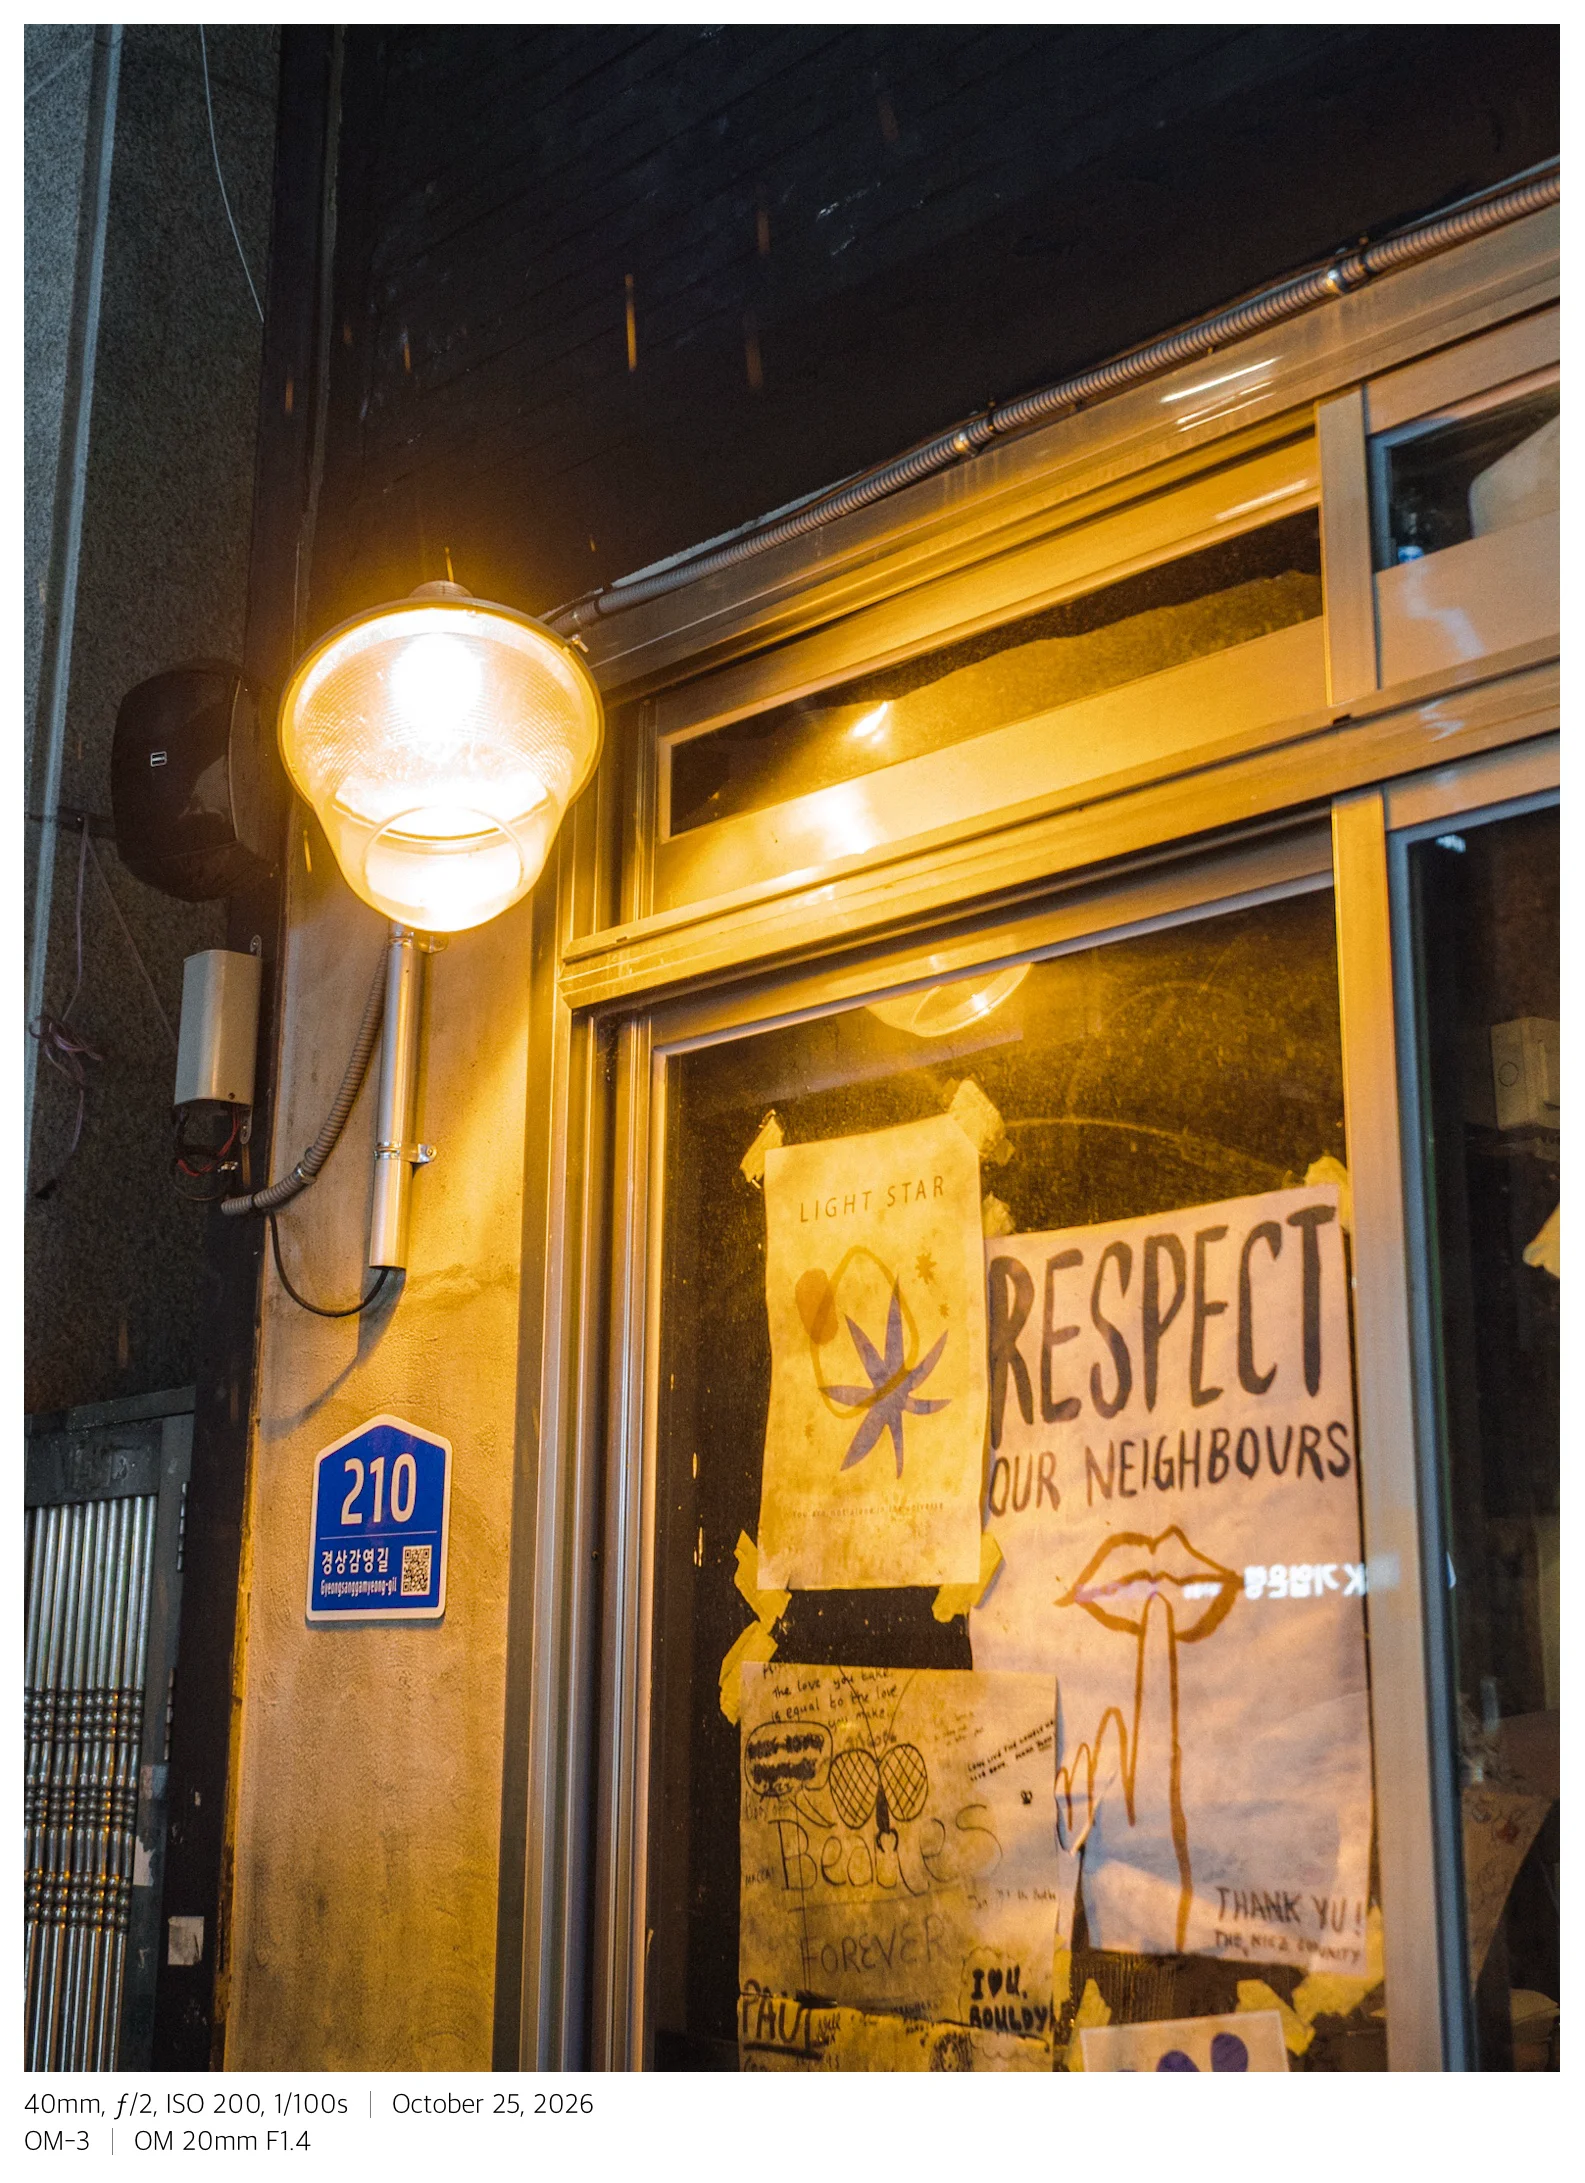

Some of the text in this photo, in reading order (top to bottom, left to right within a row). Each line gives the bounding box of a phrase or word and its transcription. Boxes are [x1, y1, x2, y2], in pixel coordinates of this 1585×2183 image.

[800, 1175, 944, 1223] LIGHT STAR
[988, 1204, 1336, 1450] RESPECT
[341, 1452, 417, 1525] 210
[988, 1421, 1351, 1518] OUR NEIGHBOURS
[321, 1547, 389, 1575] 경상감영길
[320, 1577, 397, 1598] Gyeongsanggamyeong-gil
[797, 1679, 821, 1693] love
[786, 1697, 821, 1722] equal
[829, 1694, 845, 1710] to
[1216, 1886, 1301, 1923] THANK
[800, 1913, 946, 1977] FOREVER
